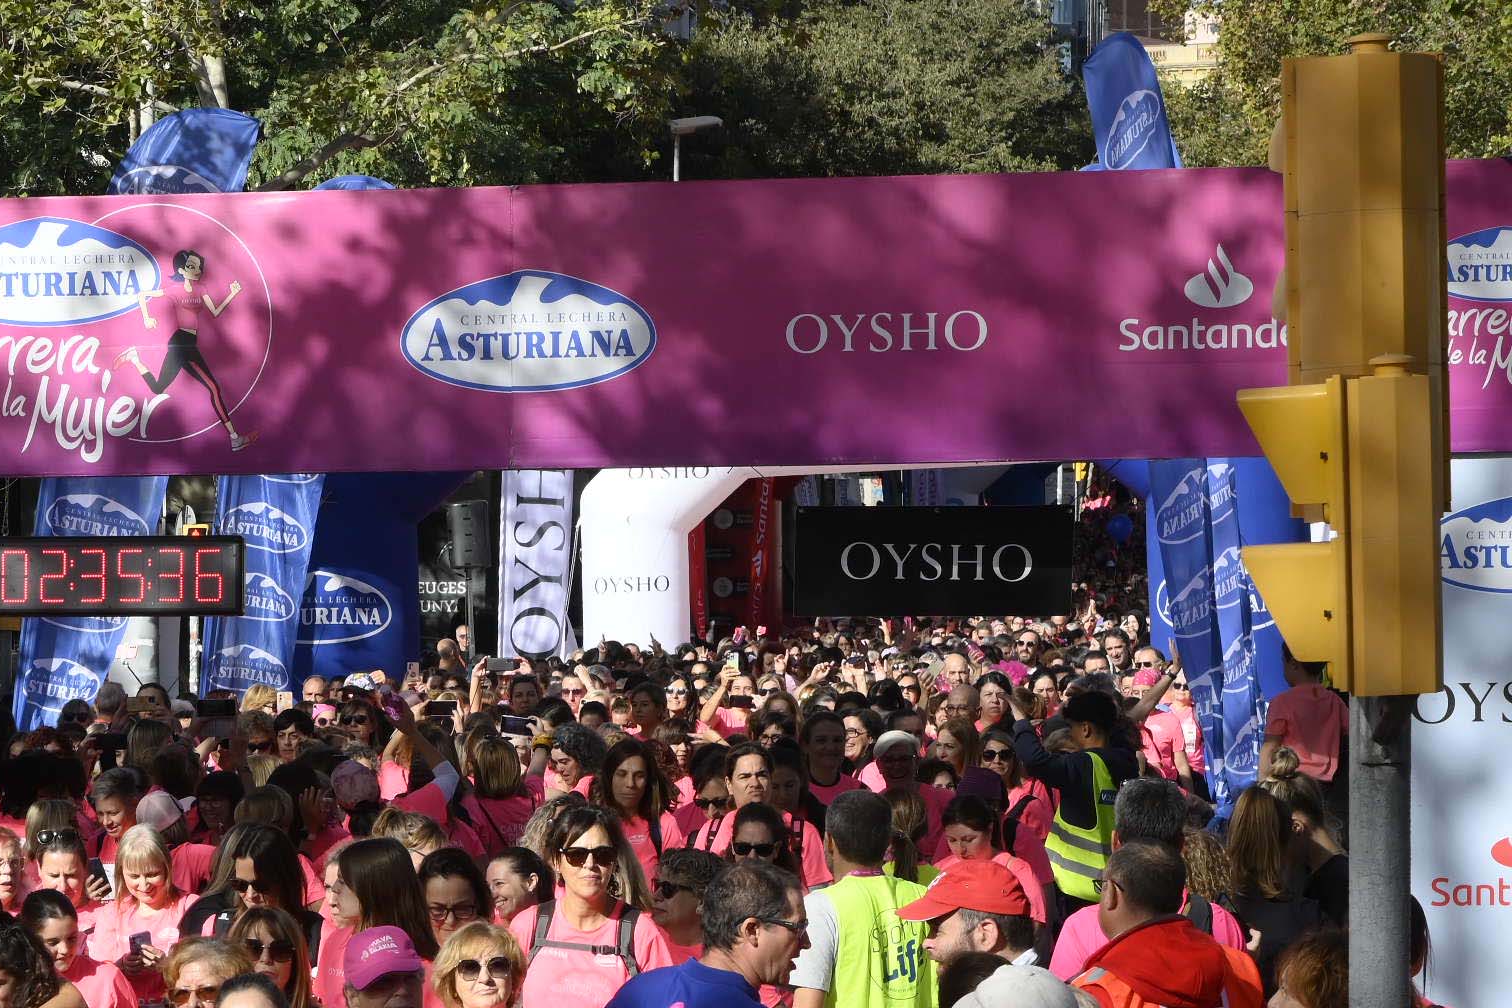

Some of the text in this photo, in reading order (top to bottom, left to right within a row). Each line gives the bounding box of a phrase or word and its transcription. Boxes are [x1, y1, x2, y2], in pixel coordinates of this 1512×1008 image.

[63, 253, 137, 266] LECHERA
[420, 317, 636, 362] ASTURIANA
[460, 310, 628, 327] CENTRAL LECHERA
[785, 310, 988, 355] OYSHO
[1468, 337, 1488, 365] la
[1, 376, 27, 417] la
[21, 368, 171, 464] Mujer
[0, 548, 224, 604] 02:35:36
[840, 541, 1034, 583] OYSHO
[593, 574, 671, 595] OYSHO
